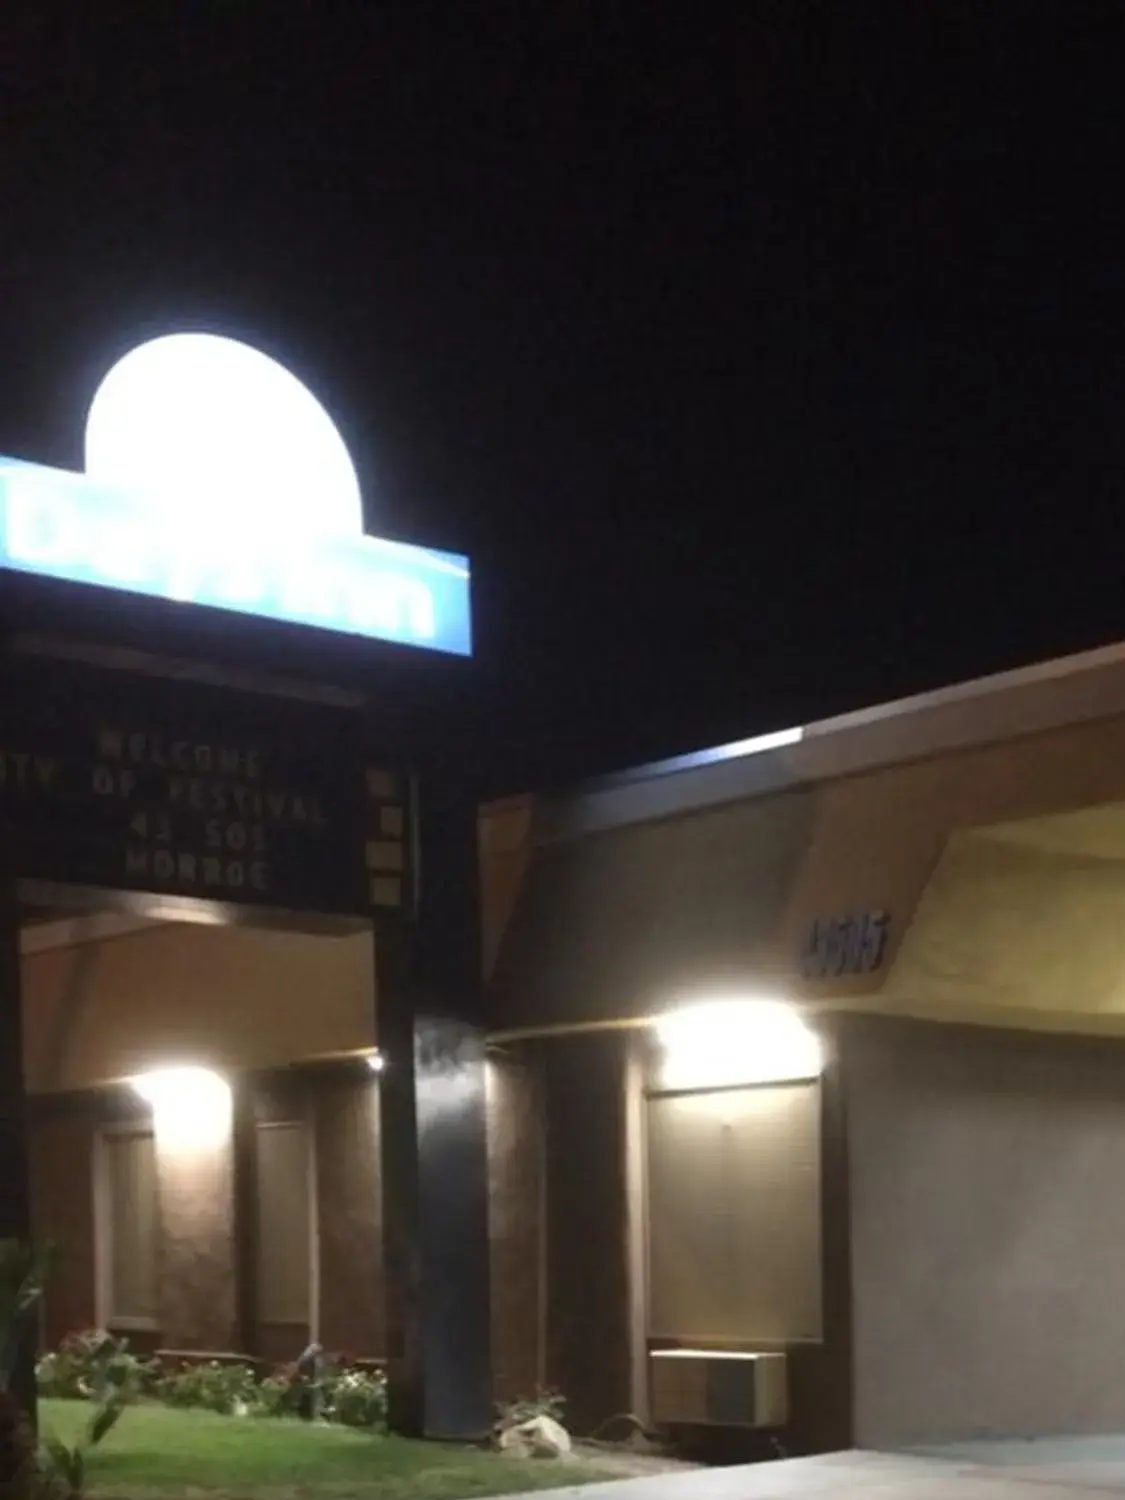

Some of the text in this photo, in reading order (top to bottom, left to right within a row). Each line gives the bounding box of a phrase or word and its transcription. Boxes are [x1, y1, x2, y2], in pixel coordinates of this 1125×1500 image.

[98, 728, 261, 778] WELCOME
[91, 763, 137, 799] OF
[168, 774, 329, 827] FESTIVAL
[123, 847, 271, 891] MONROE
